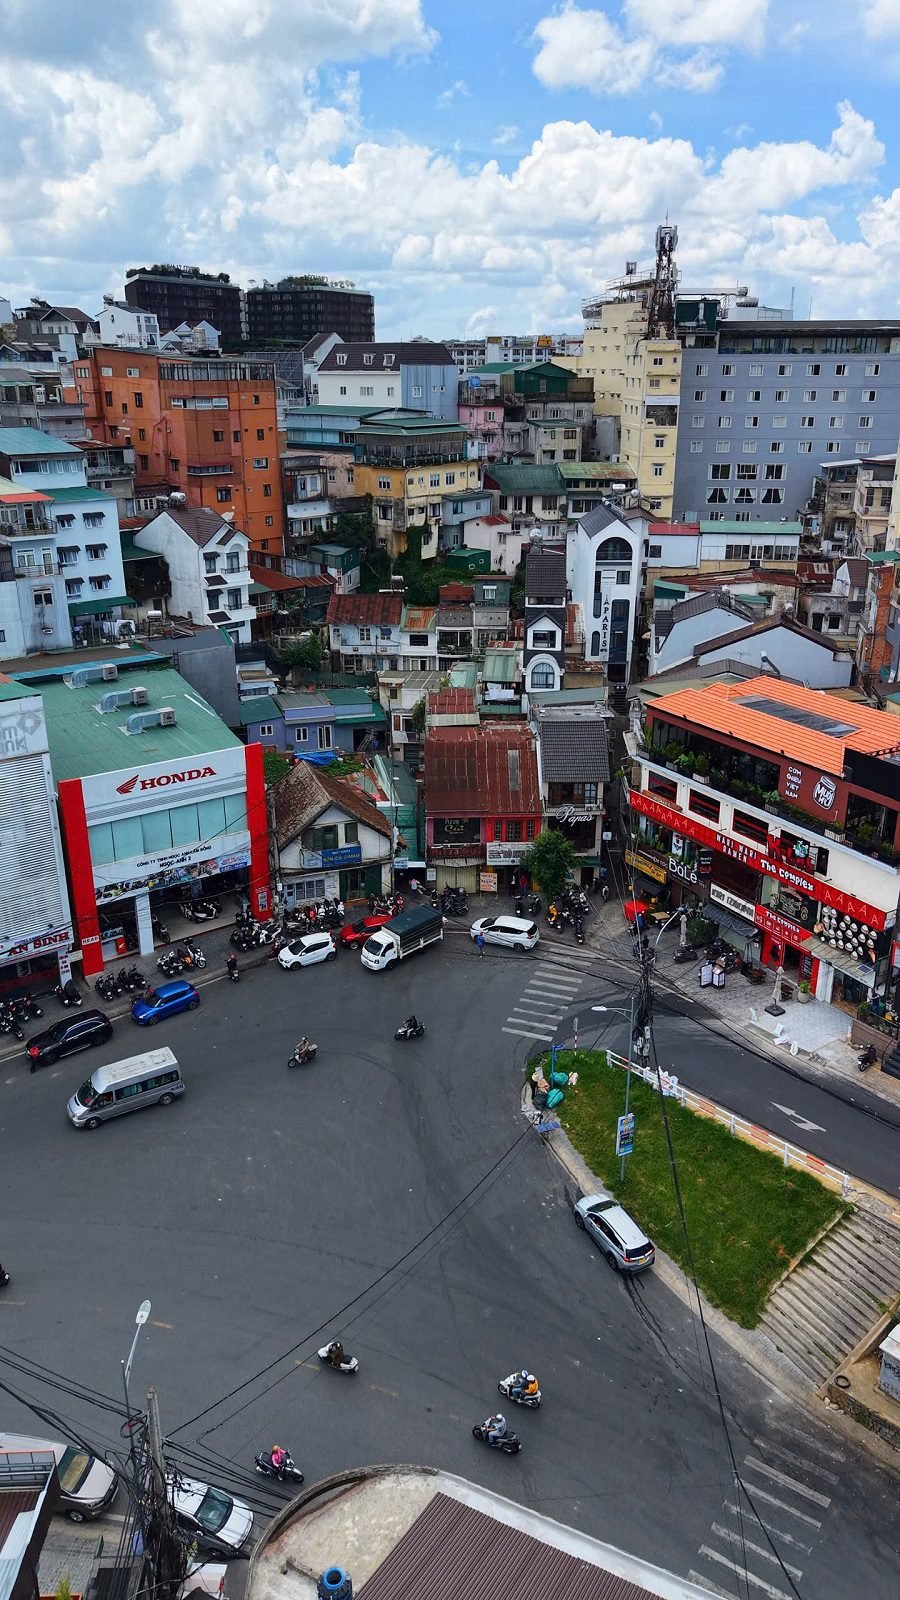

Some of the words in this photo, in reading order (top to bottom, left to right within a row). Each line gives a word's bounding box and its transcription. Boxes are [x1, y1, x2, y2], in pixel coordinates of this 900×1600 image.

[601, 606, 610, 648] PARIS
[140, 766, 217, 790] HONDA
[722, 844, 747, 863] RAMEN
[8, 944, 29, 957] AN
[33, 931, 70, 949] SINH
[82, 936, 99, 944] HEAD
